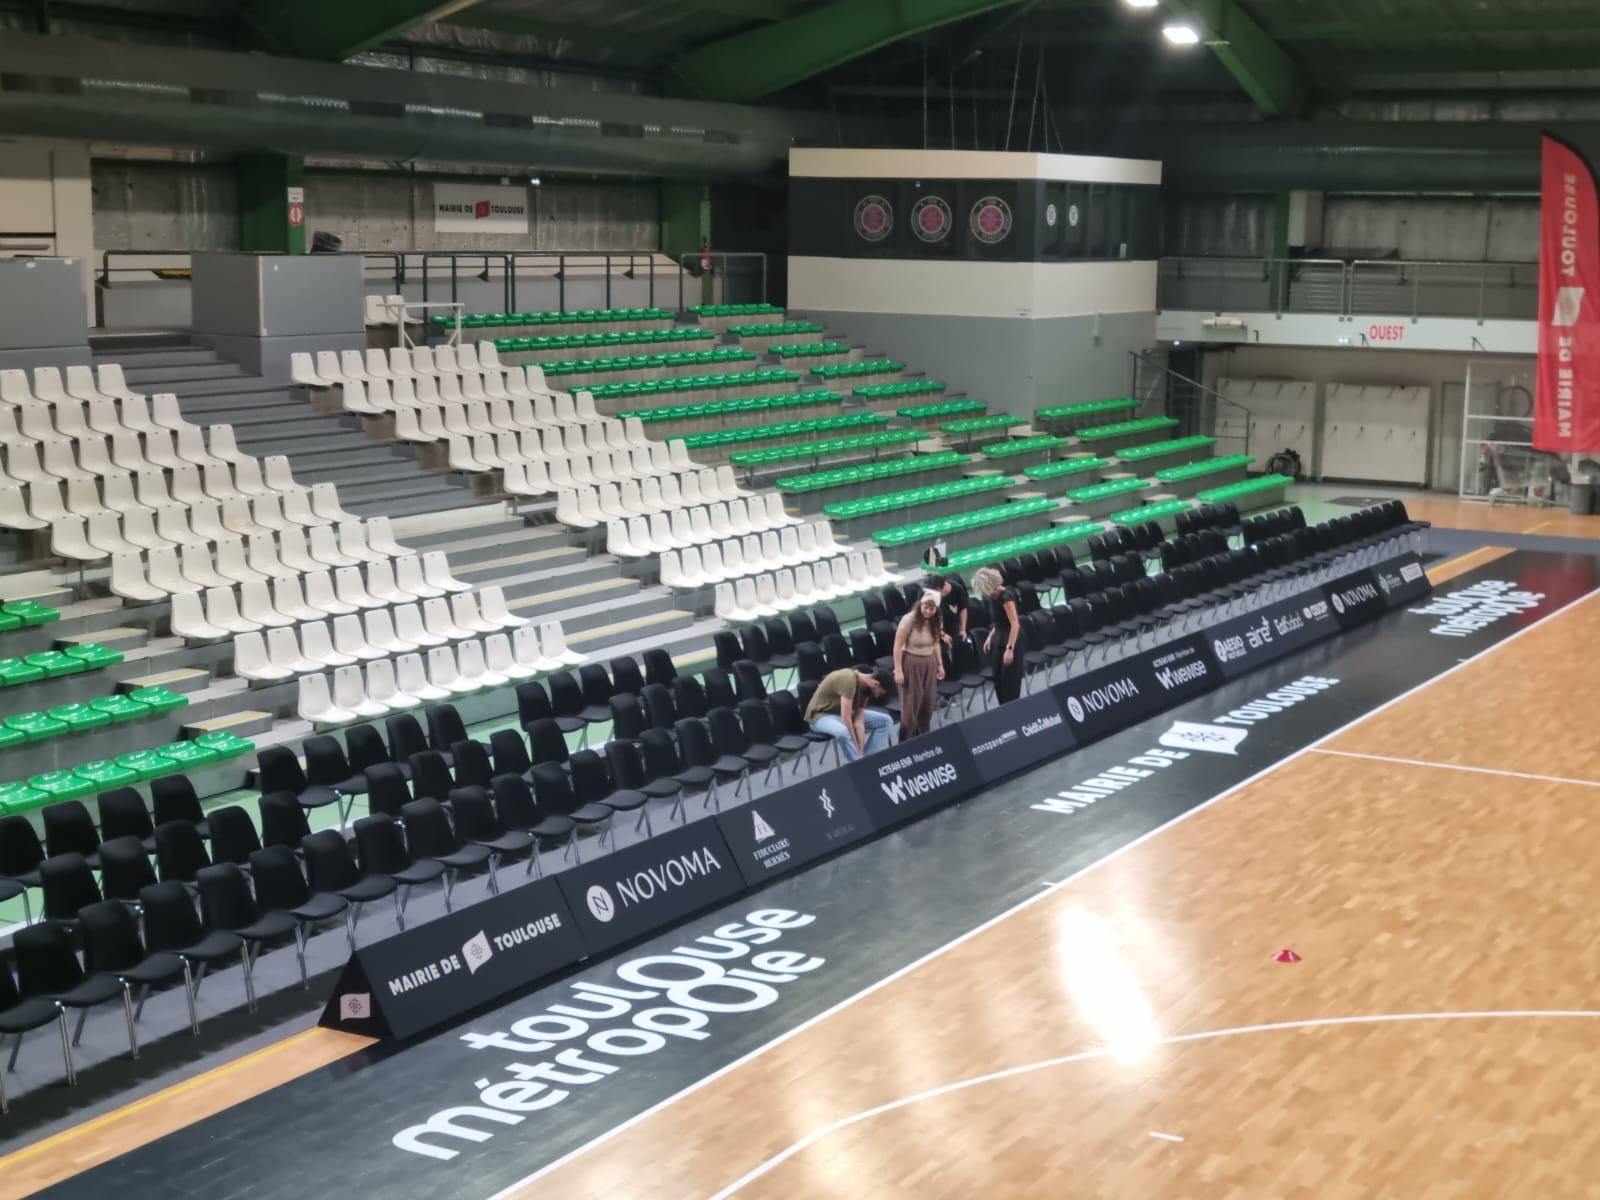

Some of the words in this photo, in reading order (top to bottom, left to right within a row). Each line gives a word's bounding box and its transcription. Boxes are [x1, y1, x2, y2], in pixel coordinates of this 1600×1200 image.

[438, 204, 462, 214] MAIRIE
[463, 205, 474, 214] DE
[491, 205, 524, 215] TOULOUSE
[1369, 325, 1404, 341] OUEST
[1341, 583, 1378, 608] NOVOMA
[1171, 660, 1207, 686] wewise
[1082, 677, 1139, 713] NOVOMA
[878, 760, 902, 777] ACTEAM
[935, 745, 944, 755] de
[1030, 766, 1155, 815] MAIRIE
[1128, 748, 1191, 769] DE
[1214, 675, 1341, 727] TOULOUSE
[904, 763, 958, 798] wewise
[615, 847, 722, 908] NOVOMA
[388, 963, 442, 997] MAIRIE
[442, 954, 461, 972] DE
[493, 912, 562, 952] TOULOUSE
[459, 908, 817, 1054] toulouse
[391, 950, 827, 1162] métropole
